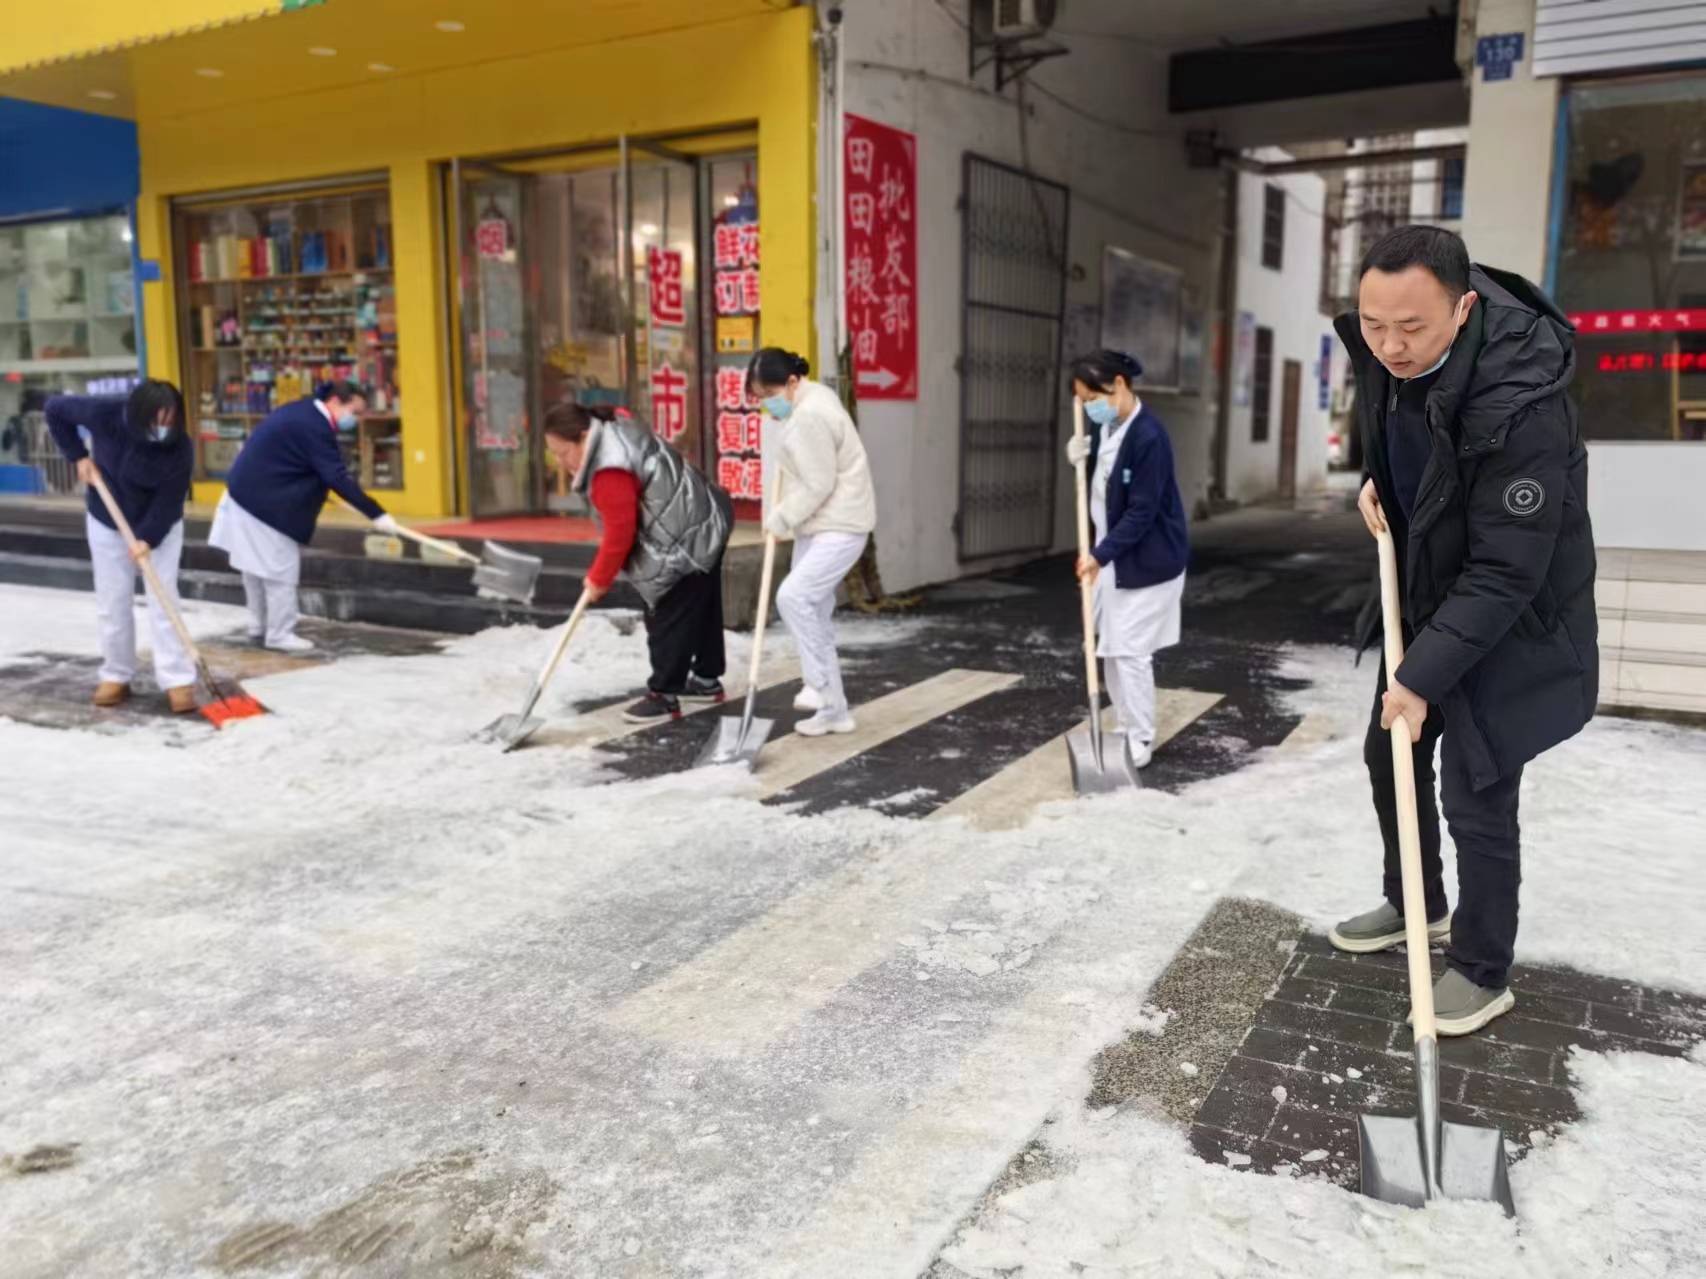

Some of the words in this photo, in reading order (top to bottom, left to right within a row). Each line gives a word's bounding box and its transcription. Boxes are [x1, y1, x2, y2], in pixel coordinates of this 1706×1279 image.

[647, 246, 687, 440] 超市
[848, 137, 879, 363] 田田粮油
[879, 162, 911, 350] 批发部
